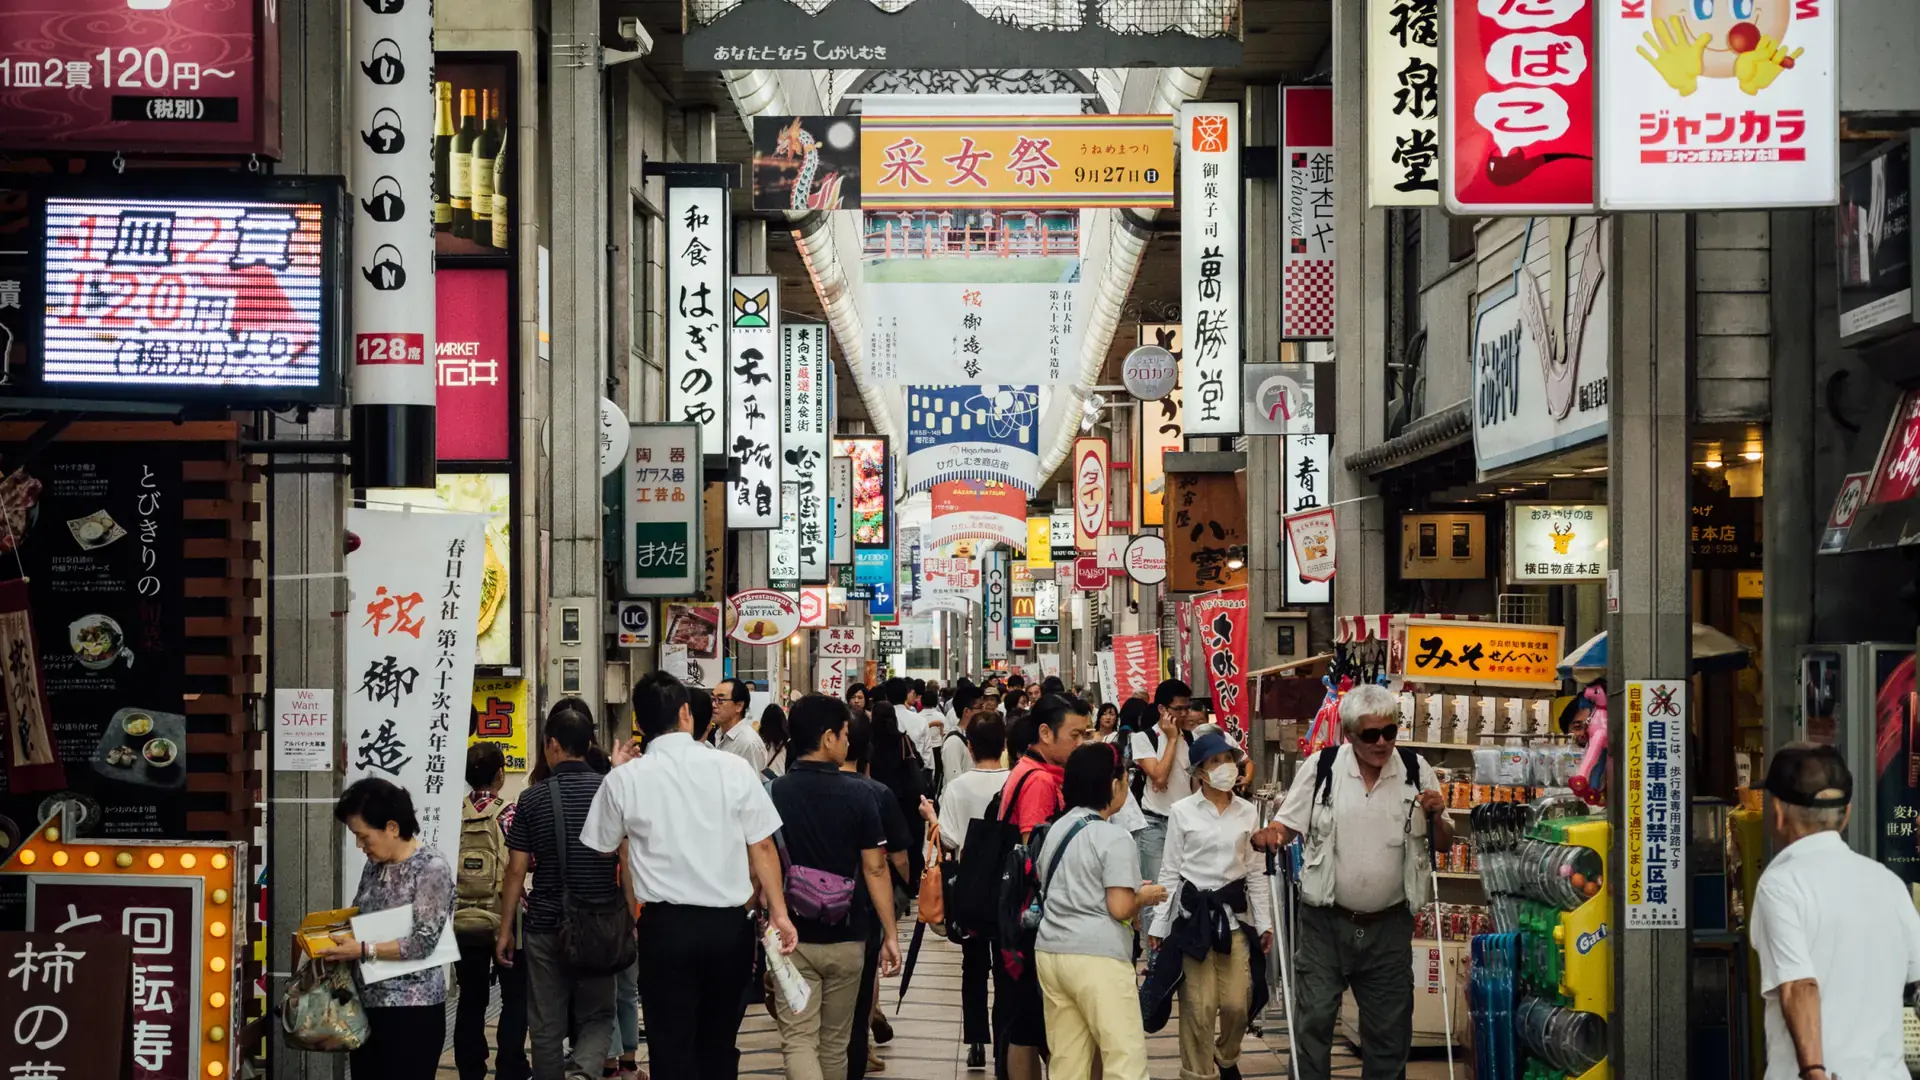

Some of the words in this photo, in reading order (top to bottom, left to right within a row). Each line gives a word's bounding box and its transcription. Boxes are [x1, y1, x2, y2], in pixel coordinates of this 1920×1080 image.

[714, 45, 806, 60] あなたとなら
[813, 39, 887, 60] ひがしむき
[145, 99, 205, 120] (税別)
[1639, 109, 1806, 146] ジャンカラ
[1079, 143, 1150, 157] うねめまつり
[880, 137, 1058, 189] 采女祭
[1074, 165, 1141, 185] 9月27日
[1202, 162, 1219, 239] 御菓子司
[682, 204, 711, 267] 和食
[359, 336, 422, 362] 128席
[435, 342, 480, 355] MARKET
[1127, 368, 1174, 380] クロカワ
[937, 457, 1010, 470] ひがしむき商店街
[636, 468, 686, 483] ガラス器
[637, 487, 686, 502] 工芸品
[1083, 469, 1099, 529] ダイソー
[1531, 509, 1594, 521] おみやげの店
[137, 465, 162, 596] とびきりの
[638, 541, 686, 568] まえだ
[1080, 568, 1105, 577] DAISO
[1524, 562, 1601, 576] 横田物産本店
[440, 538, 466, 622] 春日大社
[624, 612, 647, 625] UC
[824, 642, 861, 654] くだもの
[1416, 636, 1485, 672] みそ
[1488, 650, 1549, 664] せんべい
[297, 691, 314, 700] We
[292, 701, 319, 711] Want
[425, 629, 458, 795] 第六十次式年造替
[282, 713, 328, 726] STAFF
[477, 697, 516, 738] 占
[284, 740, 326, 748] アルバイト大募集
[1646, 721, 1667, 905] 自転車通行禁止区域
